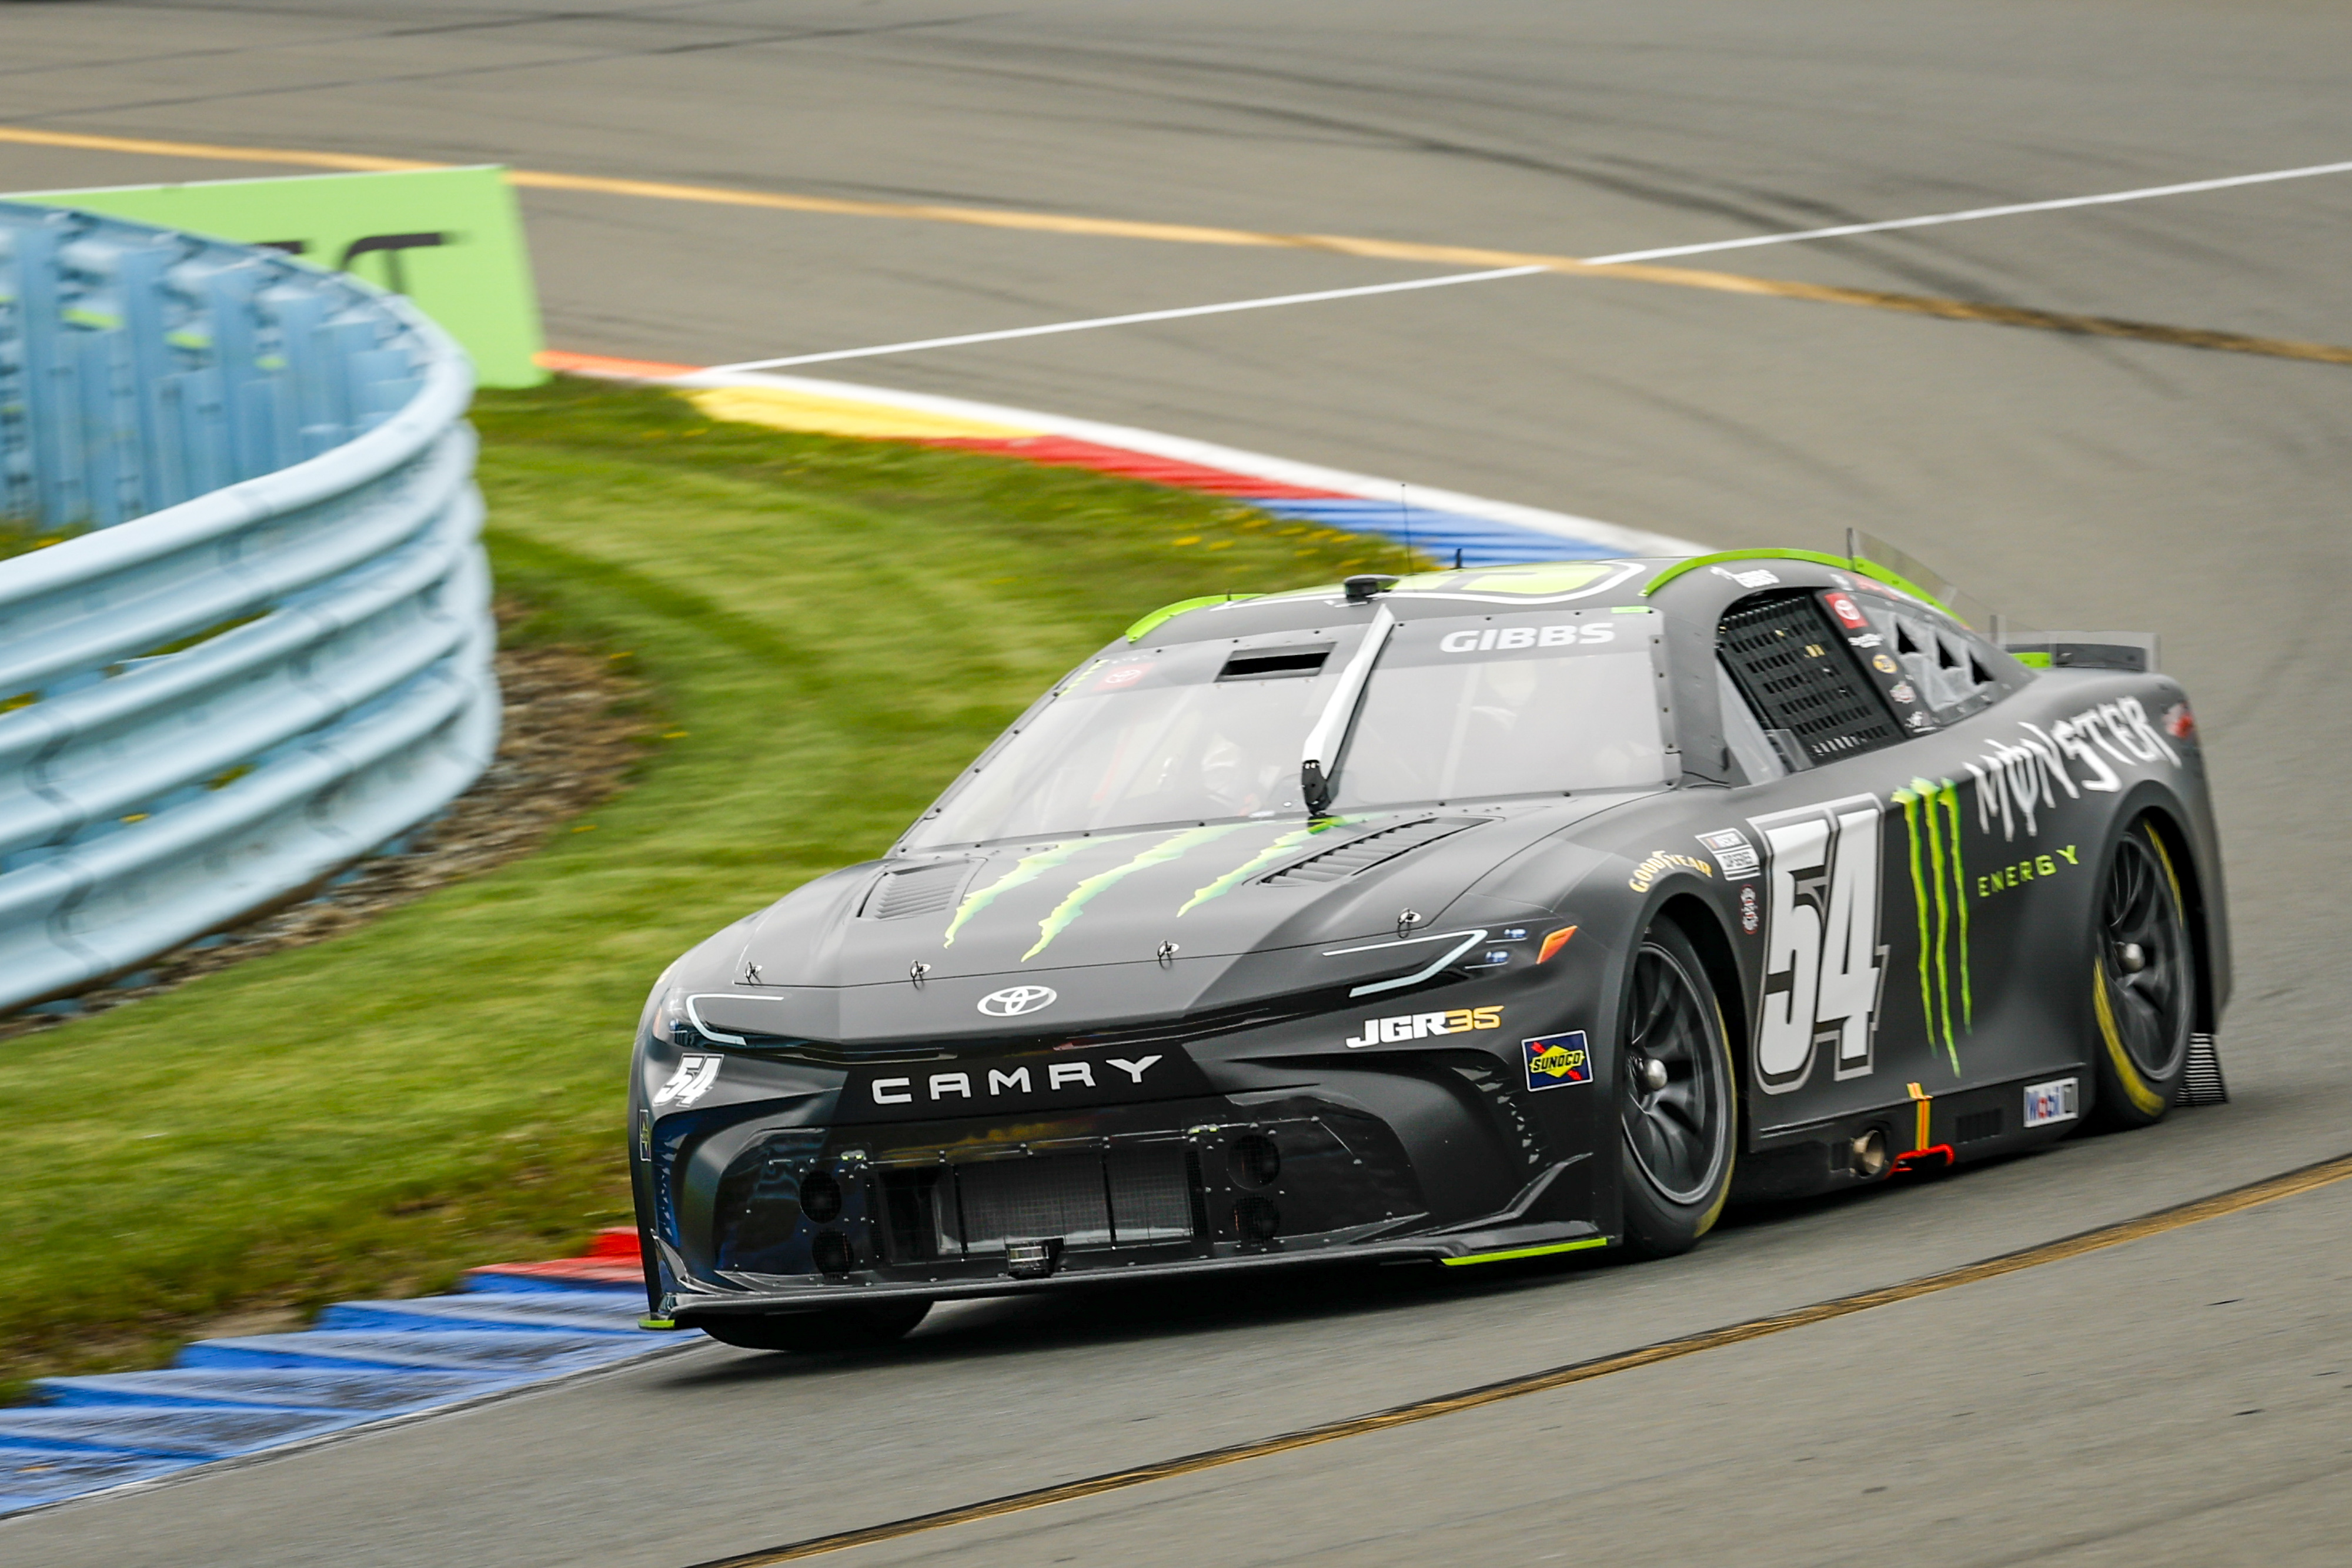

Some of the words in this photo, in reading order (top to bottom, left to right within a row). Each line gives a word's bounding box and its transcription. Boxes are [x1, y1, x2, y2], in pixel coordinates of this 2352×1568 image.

[1440, 623, 1615, 653] GIBBS
[1962, 696, 2182, 842] MONSTER
[1628, 850, 1713, 893] GOODYEAR
[1977, 845, 2079, 897] ENERGY
[1752, 798, 1886, 1086] 54
[653, 1053, 724, 1107] 54
[871, 1054, 1163, 1104] CAMRY
[1532, 1052, 1581, 1071] SUNOCO
